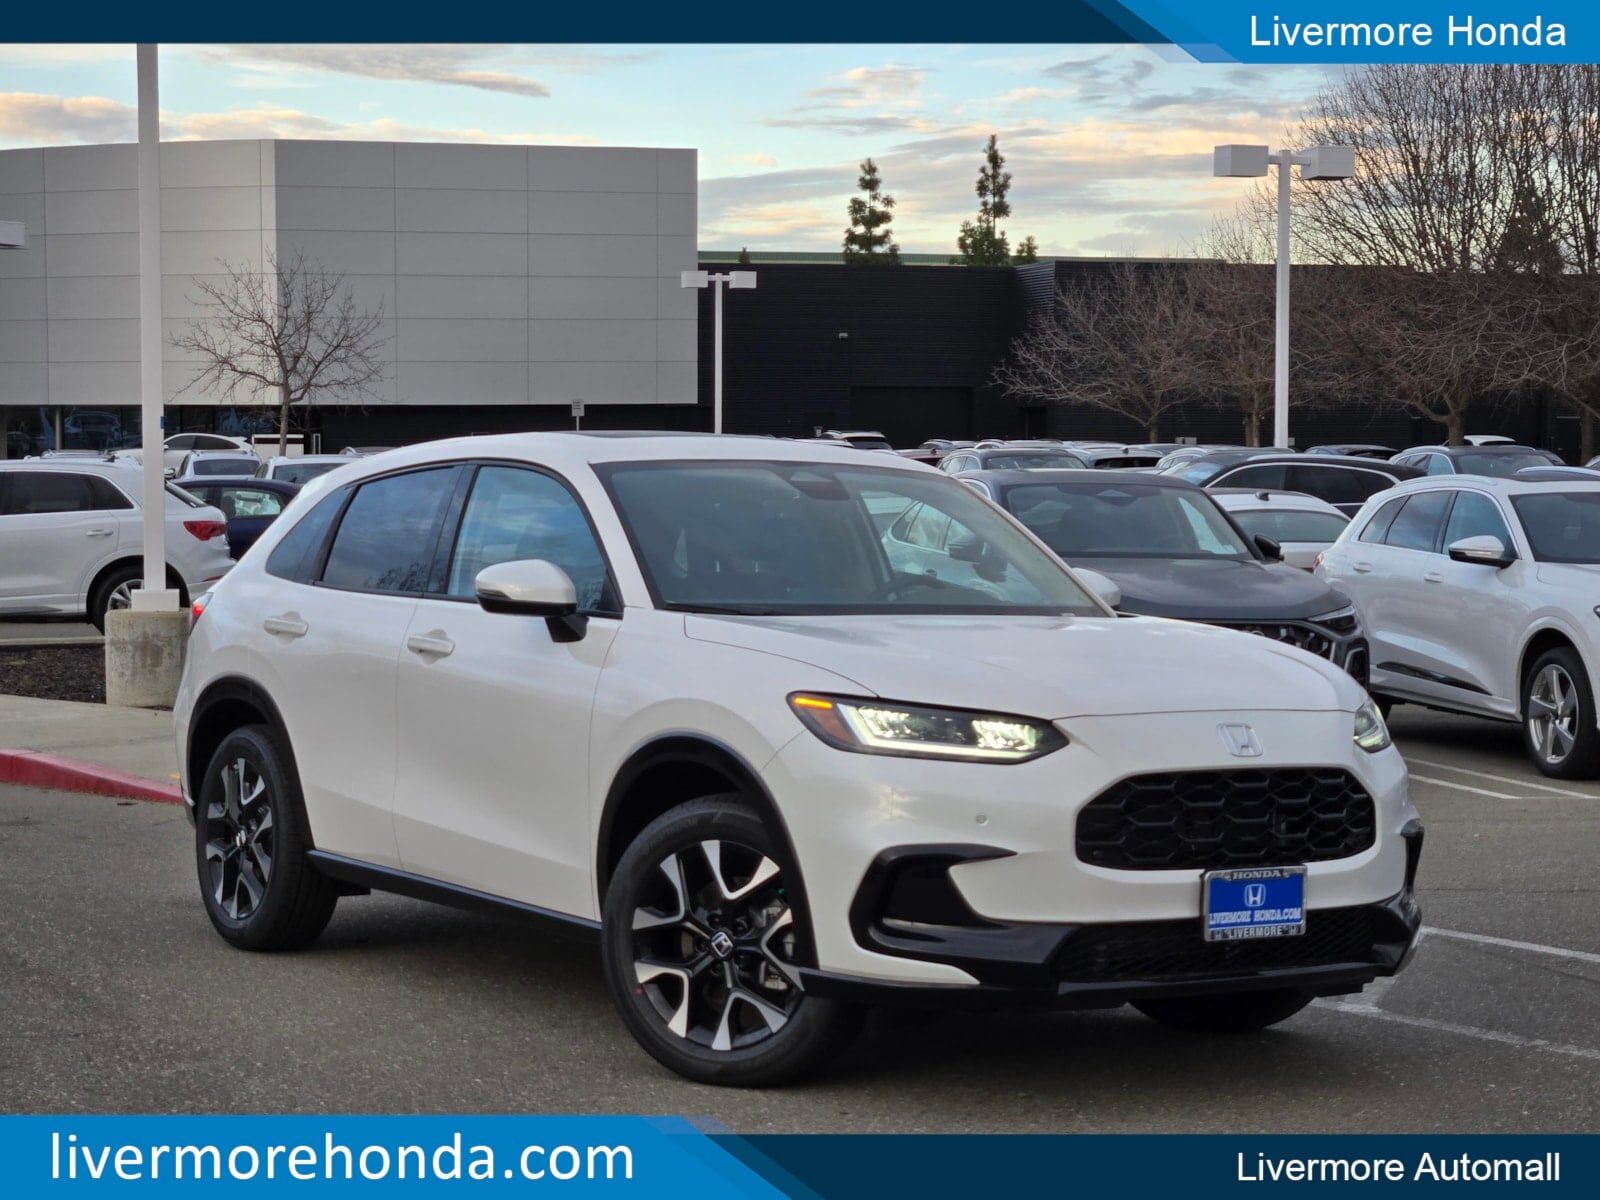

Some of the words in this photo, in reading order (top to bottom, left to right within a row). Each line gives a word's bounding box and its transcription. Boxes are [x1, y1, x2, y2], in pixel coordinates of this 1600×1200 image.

[1233, 869, 1281, 880] HONDA
[1208, 910, 1252, 925] LIVERMORE
[1253, 908, 1302, 922] HONDA.COM
[1229, 926, 1283, 938] LIVERMORE
